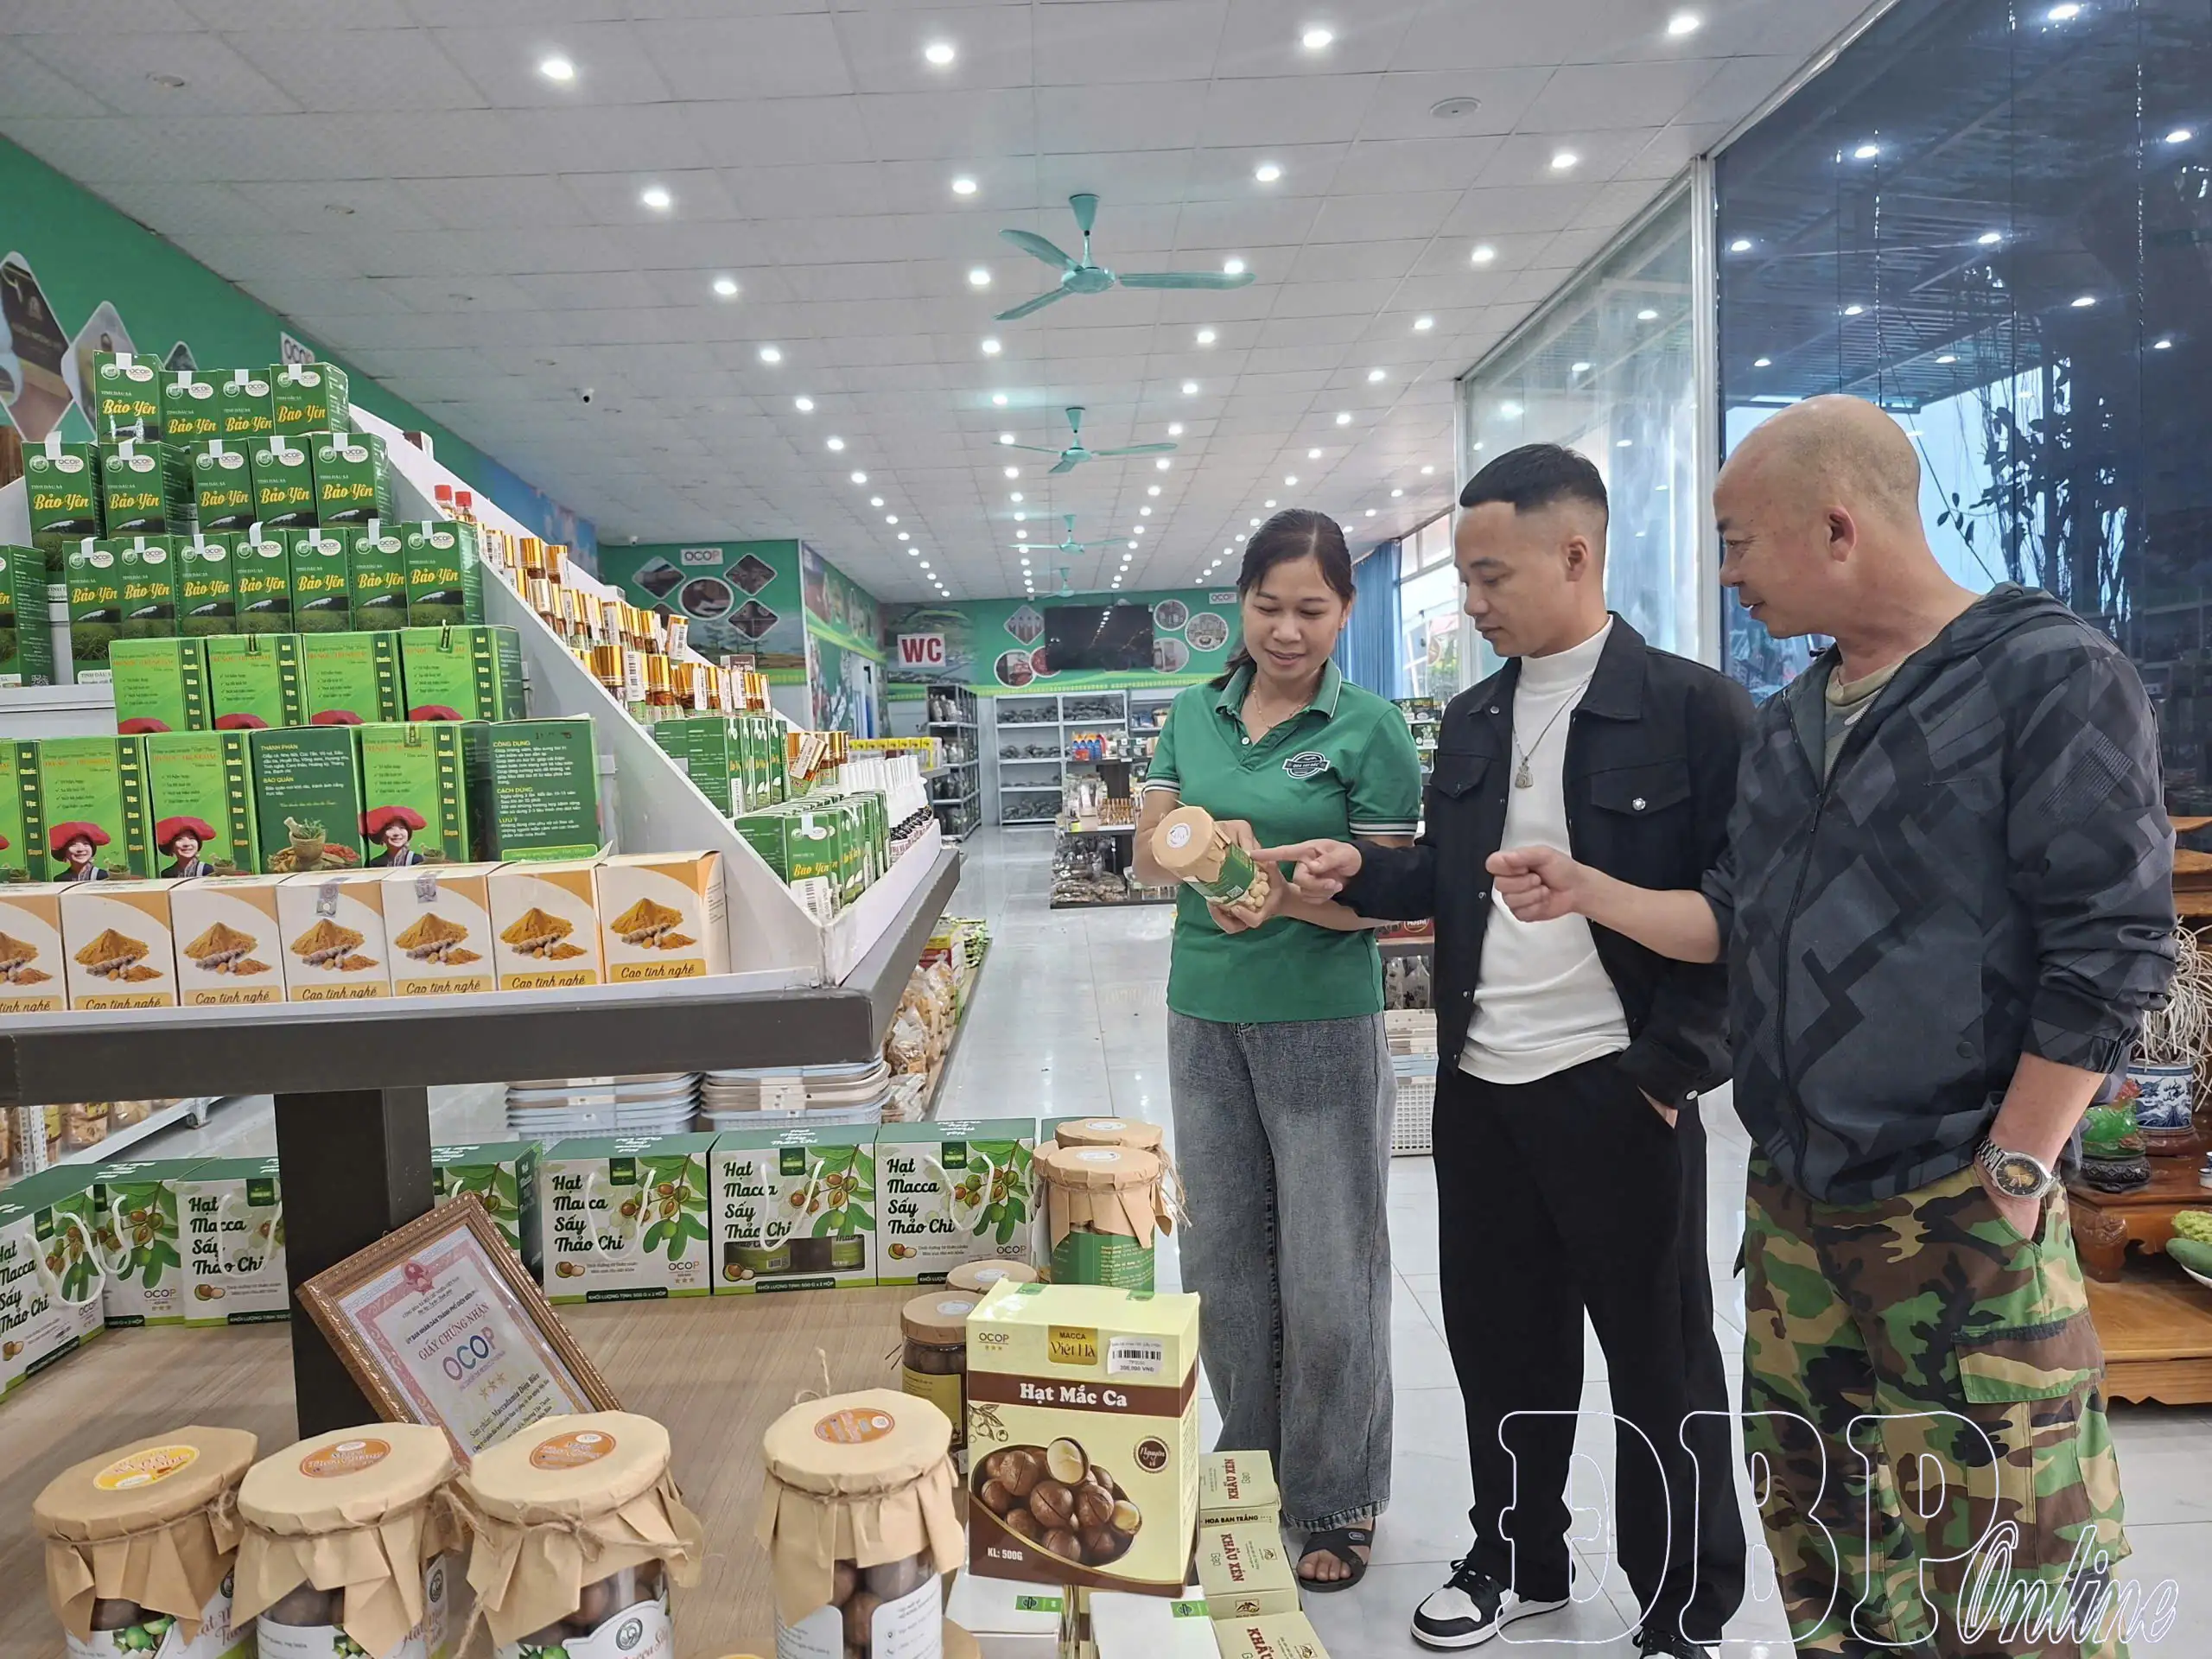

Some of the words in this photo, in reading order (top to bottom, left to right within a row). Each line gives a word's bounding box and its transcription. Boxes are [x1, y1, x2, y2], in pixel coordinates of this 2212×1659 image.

[103, 398, 130, 415] Bảo
[132, 401, 156, 416] Yên
[277, 405, 302, 423] Bảo
[306, 404, 326, 422] Yên
[168, 418, 193, 434] Bảo
[194, 419, 217, 434] Yên
[225, 416, 251, 432] Bảo
[251, 418, 272, 432] Yên
[200, 490, 225, 507] Bảo
[225, 490, 249, 507] Yên
[260, 487, 284, 504] Bảo
[285, 486, 310, 504] Yên
[322, 484, 347, 499] Bảo
[348, 483, 373, 499] Yên
[34, 493, 62, 511] Bảo
[64, 494, 90, 511] Yên
[109, 493, 135, 510] Bảo
[136, 493, 160, 510] Yên
[684, 550, 720, 561] OCOP
[238, 577, 262, 593] Bảo
[264, 576, 285, 593] Yên
[297, 575, 321, 591] Bảo
[322, 574, 345, 590] Yên
[357, 571, 382, 588] Bảo
[383, 572, 405, 588] Yên
[410, 568, 435, 584] Bảo
[436, 568, 459, 584] Yên
[72, 588, 94, 604] Bảo
[95, 587, 118, 603] Yên
[124, 583, 147, 600] Bảo
[148, 582, 169, 600] Yên
[183, 581, 207, 597] Bảo
[207, 581, 230, 596] Yên
[0, 592, 10, 605] ên
[1211, 594, 1236, 602] OCOP
[901, 638, 942, 664] WC
[621, 967, 641, 978] Cao
[406, 982, 427, 994] Cao
[512, 977, 531, 988] Cao
[195, 993, 216, 1004] Cao
[302, 989, 322, 1001] Cao
[86, 999, 107, 1010] Cao
[723, 1161, 753, 1179] Hạt
[887, 1158, 916, 1176] Hạt
[552, 1175, 583, 1193] Hạt
[887, 1179, 940, 1193] Macca
[188, 1196, 219, 1215] Hạt
[725, 1201, 756, 1222] Sấy
[888, 1198, 918, 1217] Sấy
[555, 1214, 587, 1235] Sấy
[766, 1221, 791, 1236] Chi
[888, 1218, 926, 1234] Thảo
[929, 1218, 955, 1233] Chi
[555, 1236, 594, 1252] Thảo
[598, 1235, 625, 1250] Chi
[996, 1246, 1027, 1255] OCOP
[238, 1255, 265, 1272] Chi
[668, 1261, 700, 1270] OCOP
[0, 1260, 36, 1286] Macca
[0, 1286, 22, 1311] Sấy
[144, 1289, 176, 1299] OCOP
[0, 1307, 29, 1333] Thảo
[31, 1294, 49, 1317] Chi
[418, 1339, 441, 1361] GIẤY
[438, 1322, 468, 1345] CHỨNG
[467, 1301, 490, 1325] NHẬN
[978, 1332, 1009, 1343] OCOP
[442, 1326, 497, 1382] OCOP
[1050, 1340, 1074, 1357] Việt
[1077, 1343, 1096, 1358] Hà
[1020, 1383, 1054, 1405] Hạt
[1059, 1384, 1097, 1405] Mắc
[1103, 1389, 1128, 1407] Ca
[1223, 1475, 1239, 1500] KHẨU
[1236, 1513, 1259, 1522] TRẮNG
[988, 1547, 1001, 1558] KL:
[1002, 1549, 1023, 1560] 500G
[1220, 1534, 1241, 1563] KHẨU
[1229, 1561, 1244, 1582] XÉN
